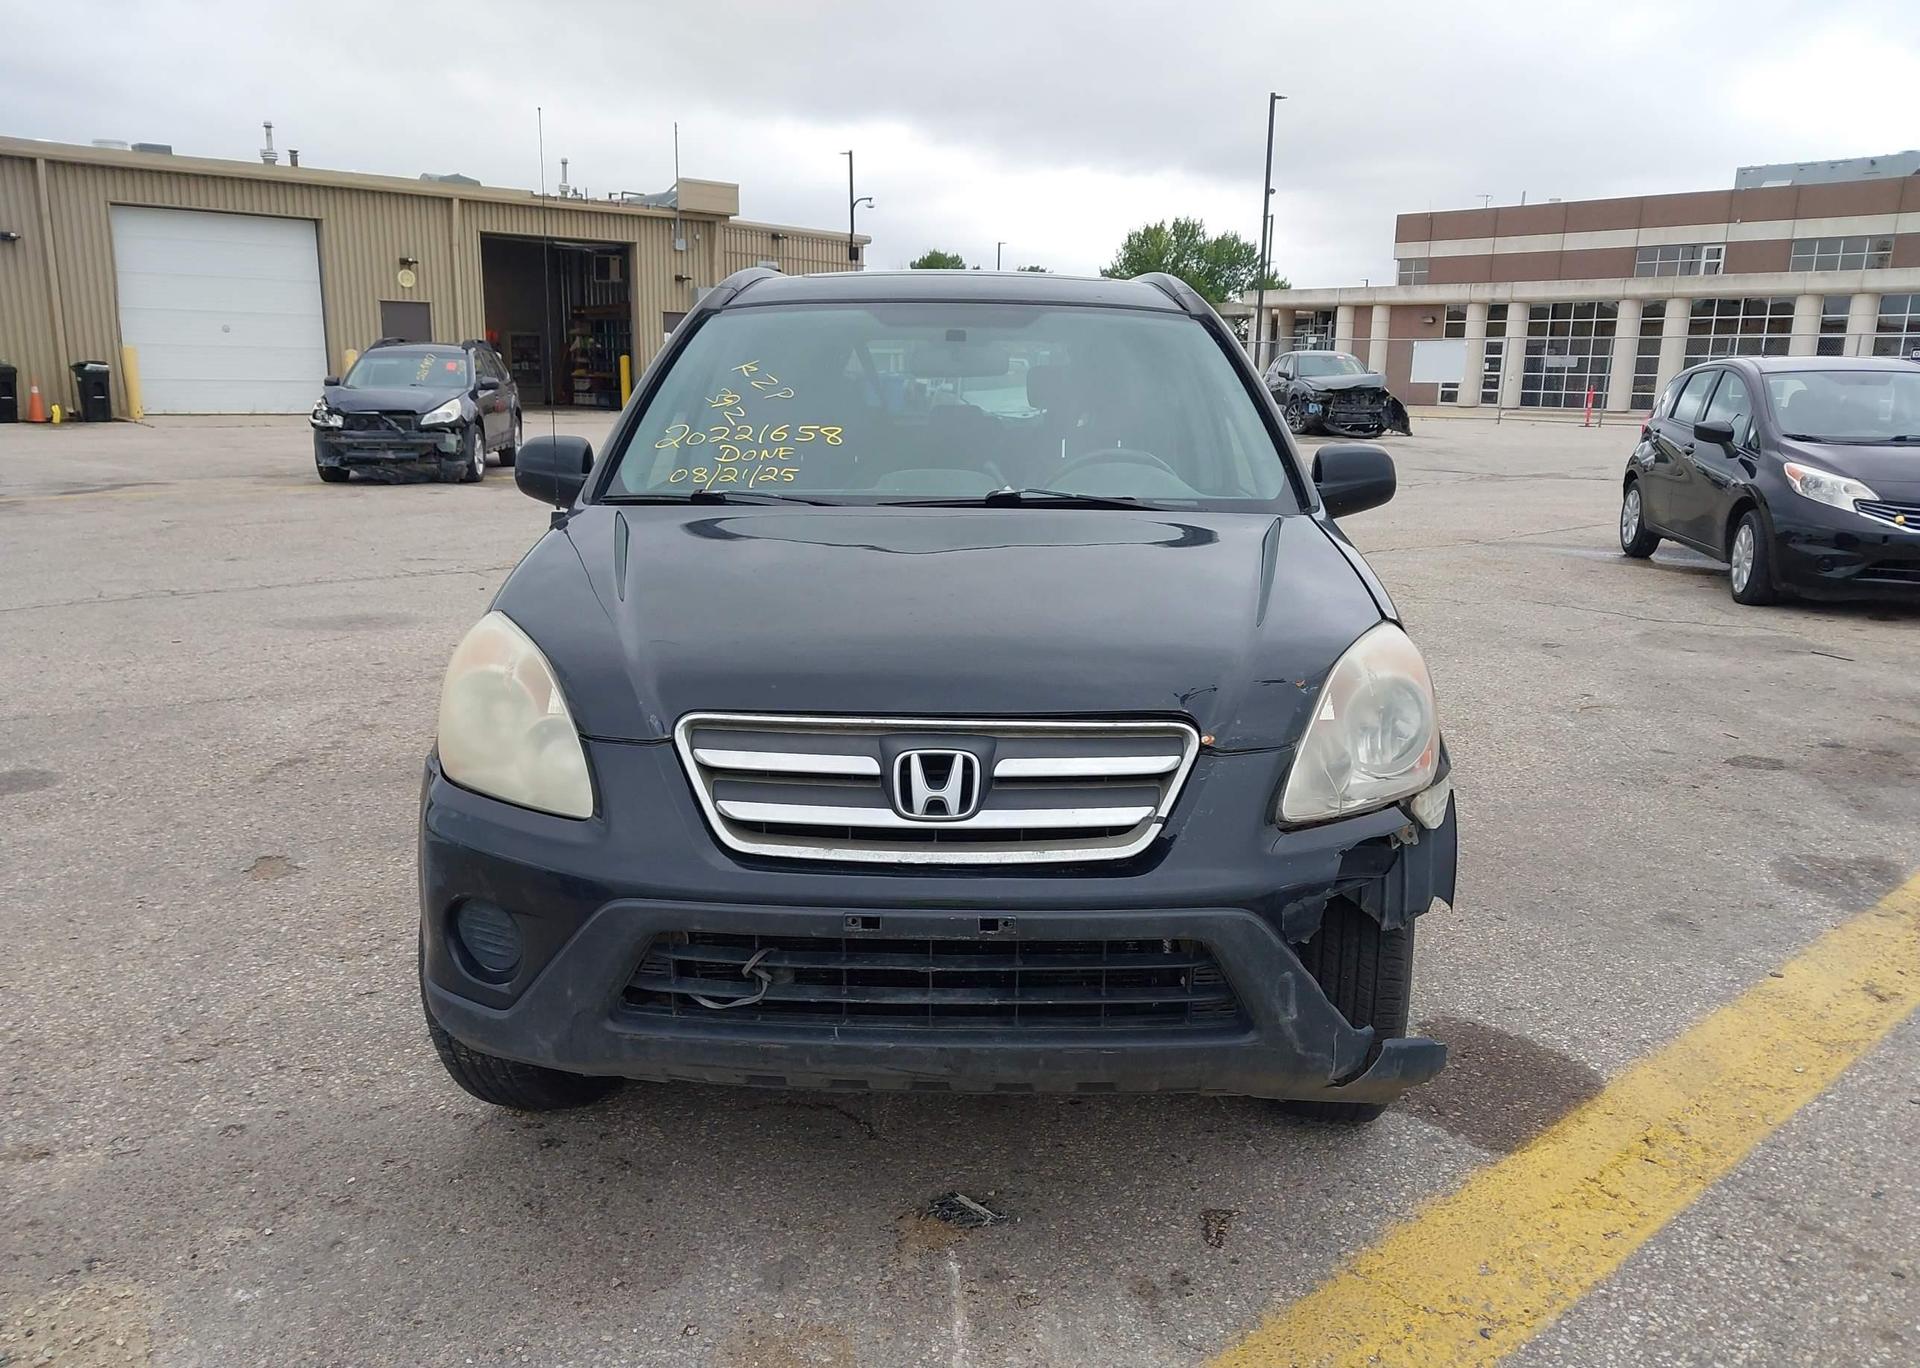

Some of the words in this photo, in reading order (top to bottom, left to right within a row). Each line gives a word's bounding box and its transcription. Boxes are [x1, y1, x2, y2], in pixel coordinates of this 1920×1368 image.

[655, 424, 843, 448] 20221658
[714, 445, 795, 462] DONE
[669, 463, 800, 490] 08/21/25
